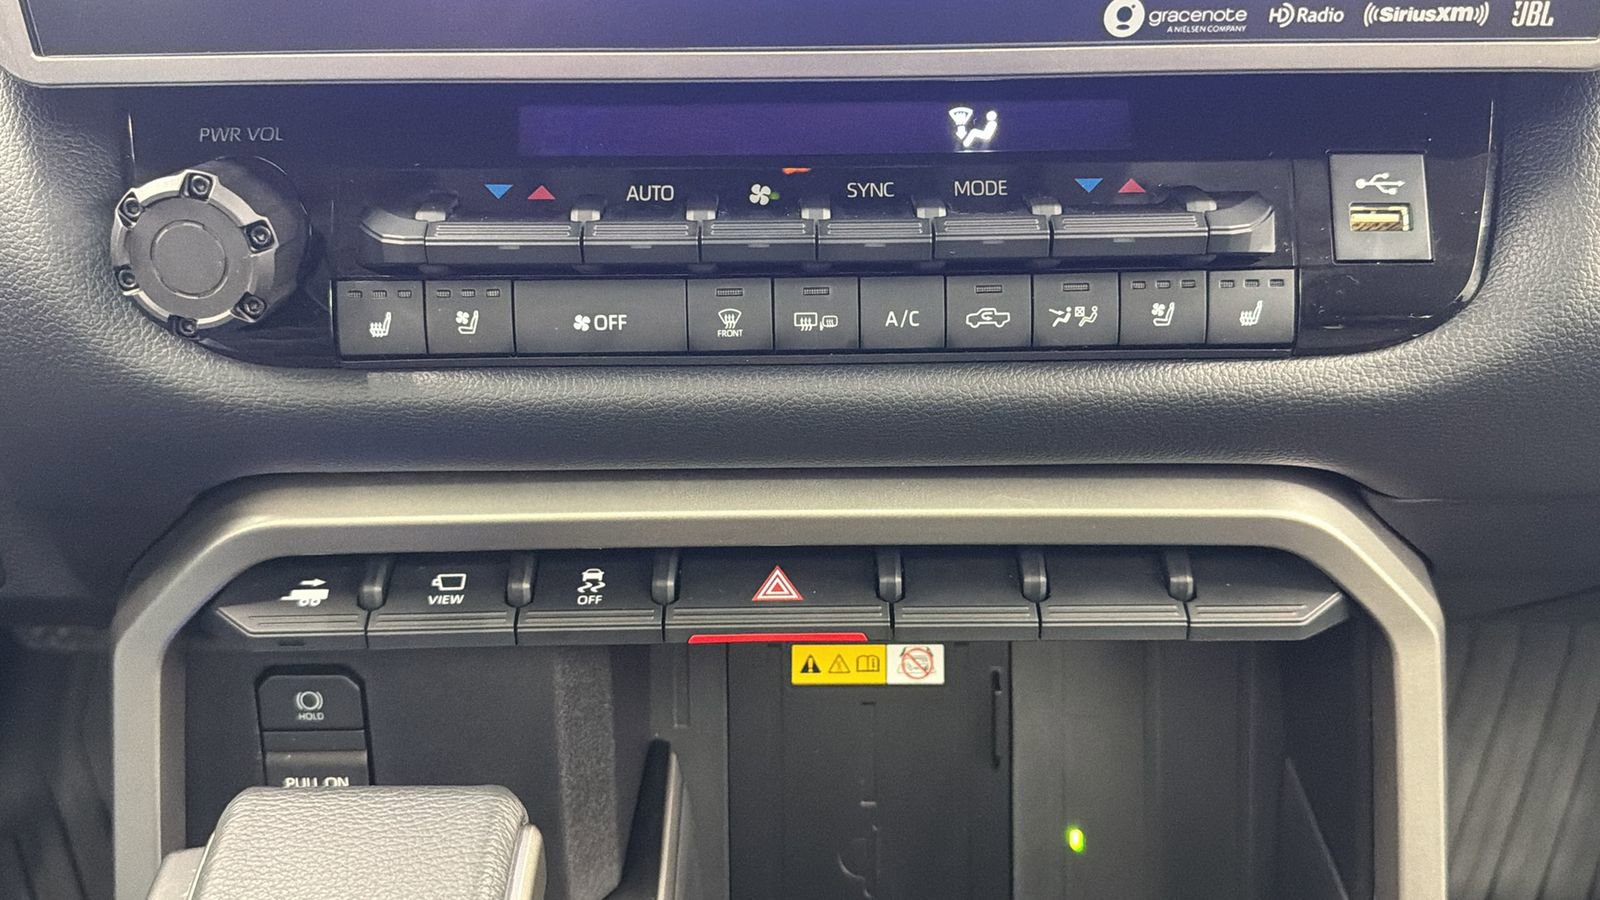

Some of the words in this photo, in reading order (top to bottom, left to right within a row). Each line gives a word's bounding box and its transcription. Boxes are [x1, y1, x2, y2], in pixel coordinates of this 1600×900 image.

[1148, 7, 1248, 27] gracenote
[1297, 7, 1345, 23] Radio
[1511, 1, 1554, 27] JBL
[1174, 25, 1206, 33] NIELSEN
[1207, 25, 1247, 33] COMPANY
[199, 127, 241, 142] PWR
[247, 126, 283, 141] VOL
[626, 185, 675, 201] AUTO
[846, 181, 895, 198] SYNC
[954, 180, 1009, 197] MODE
[593, 314, 628, 331] OFF
[885, 309, 920, 328] A/C
[717, 329, 743, 338] FRONT
[427, 594, 465, 605] VIEW
[577, 594, 603, 606] OFF
[298, 712, 325, 721] HOLD
